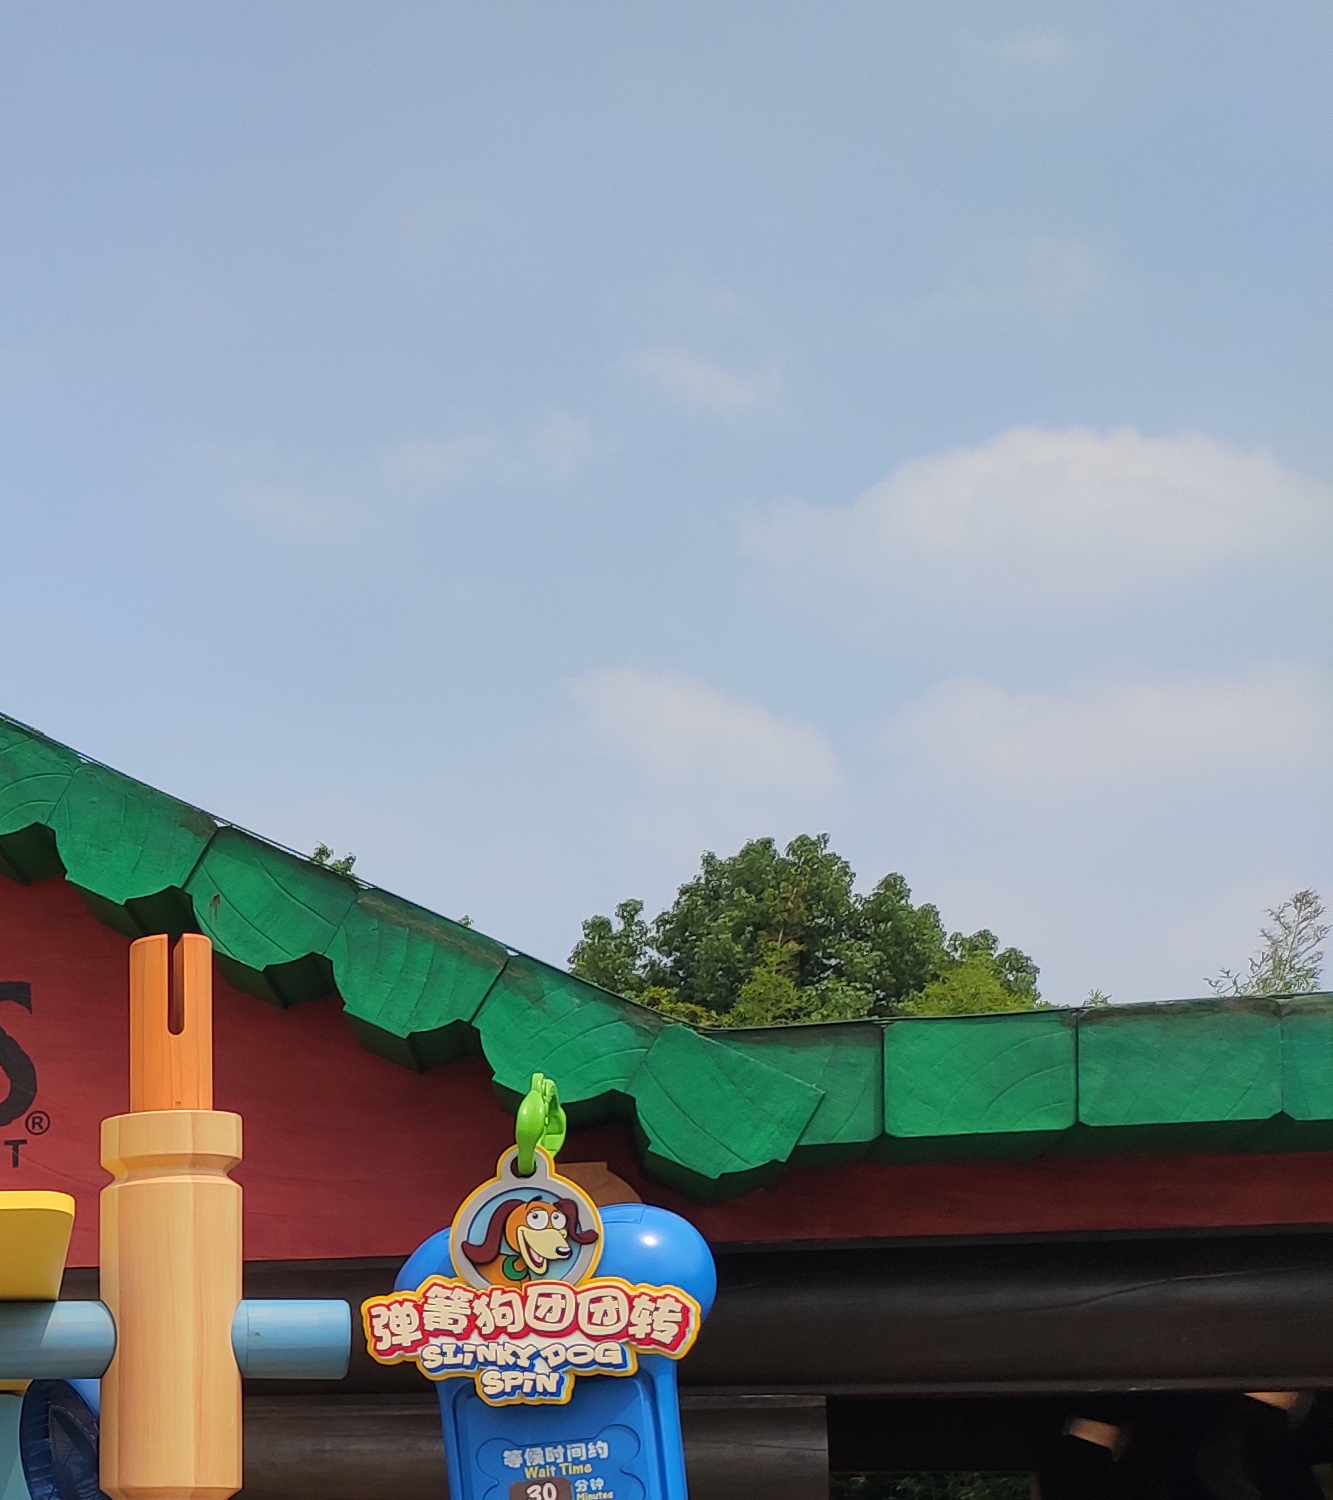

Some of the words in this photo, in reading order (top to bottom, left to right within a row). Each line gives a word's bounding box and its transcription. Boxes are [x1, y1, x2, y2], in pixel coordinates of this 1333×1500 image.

[371, 1284, 683, 1350] 弹簧狗团团转
[540, 1342, 624, 1368] DOG
[503, 1440, 609, 1468] 等候时间约
[524, 1466, 556, 1479] Wait
[559, 1462, 593, 1476] Time
[574, 1477, 605, 1492] 分钟
